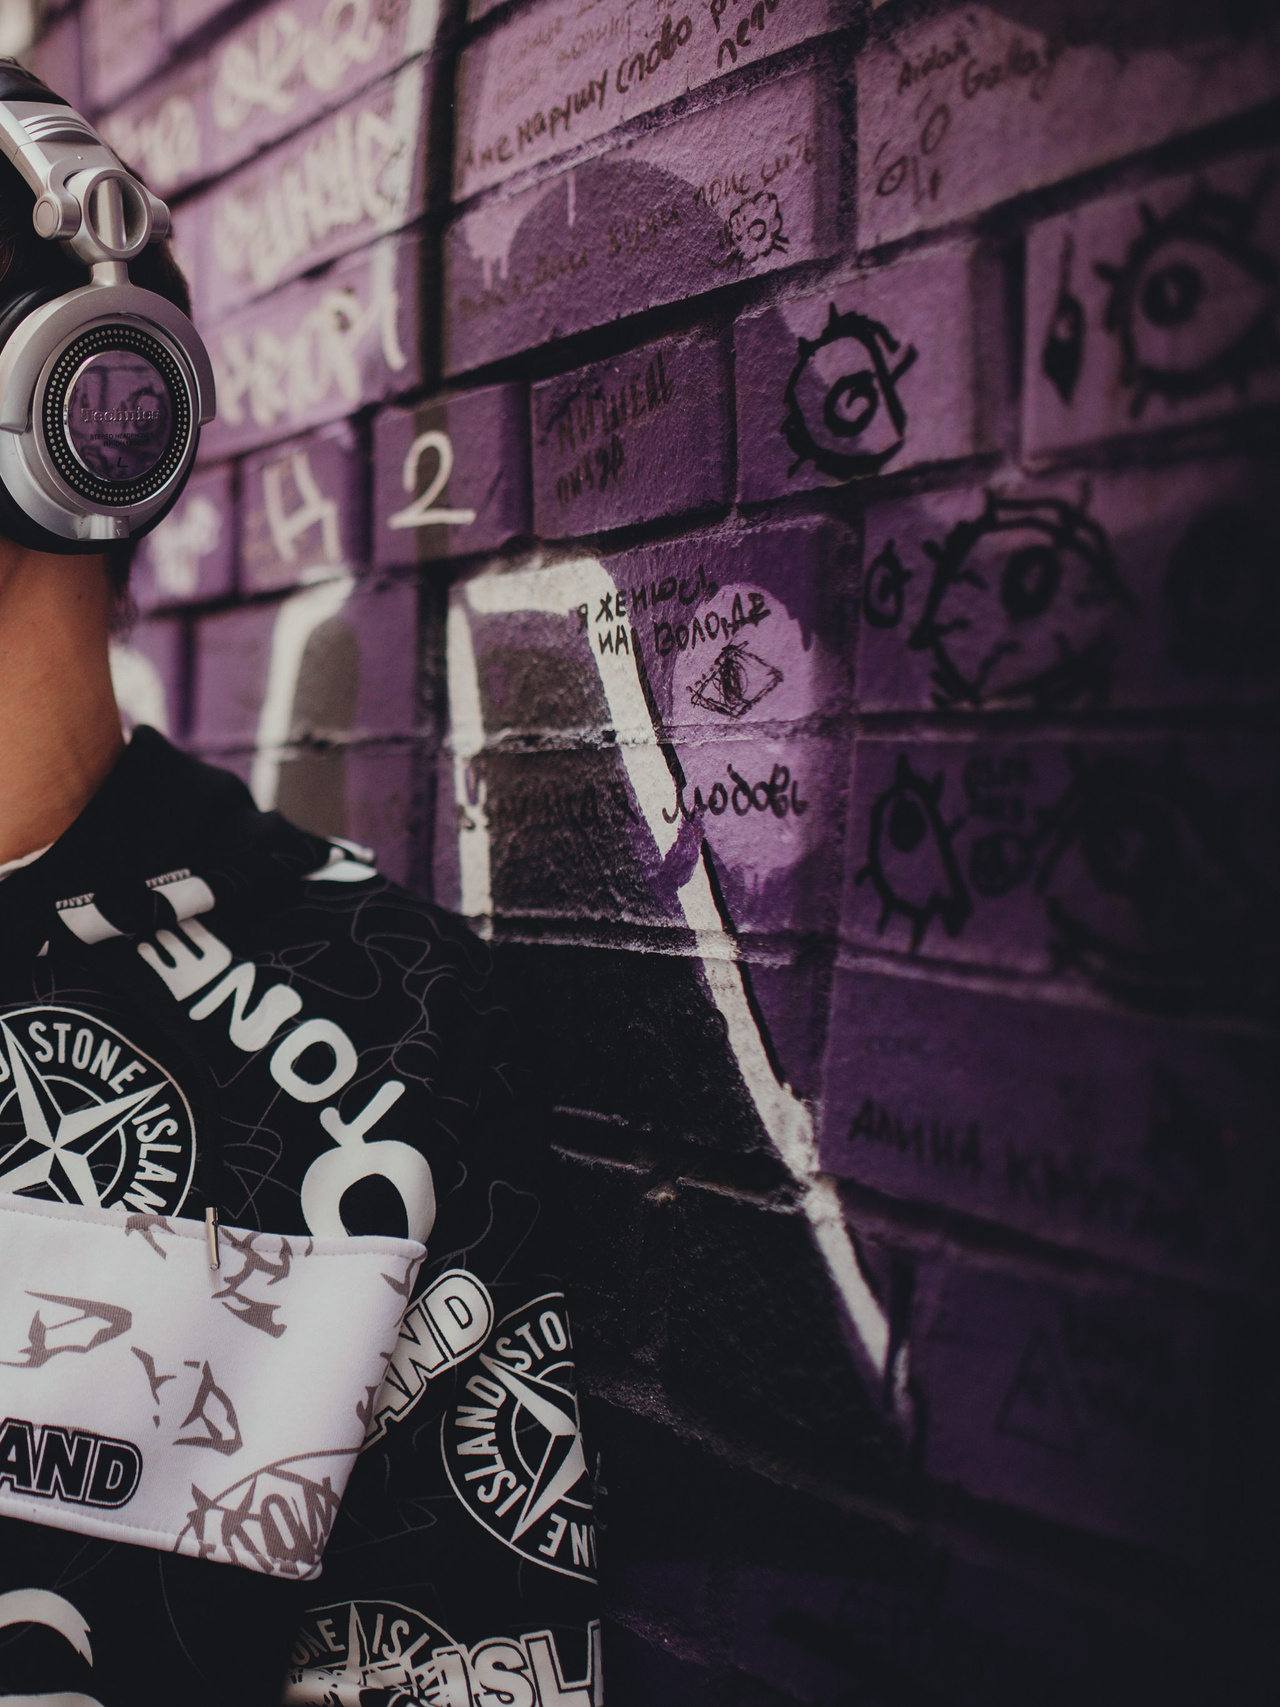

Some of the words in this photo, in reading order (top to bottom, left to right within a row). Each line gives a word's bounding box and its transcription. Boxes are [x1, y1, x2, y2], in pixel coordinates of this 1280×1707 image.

[81, 407, 160, 423] Technics
[117, 457, 128, 468] L
[595, 564, 719, 623] ЖЕНЮСЬ
[598, 624, 630, 656] НА
[653, 592, 771, 657] ВОЛОДЕ
[28, 1021, 146, 1094] STONE
[111, 1103, 181, 1216] ISLAN
[496, 1310, 573, 1372] STO
[455, 1374, 527, 1518] ISLAND
[538, 1512, 597, 1569] NE
